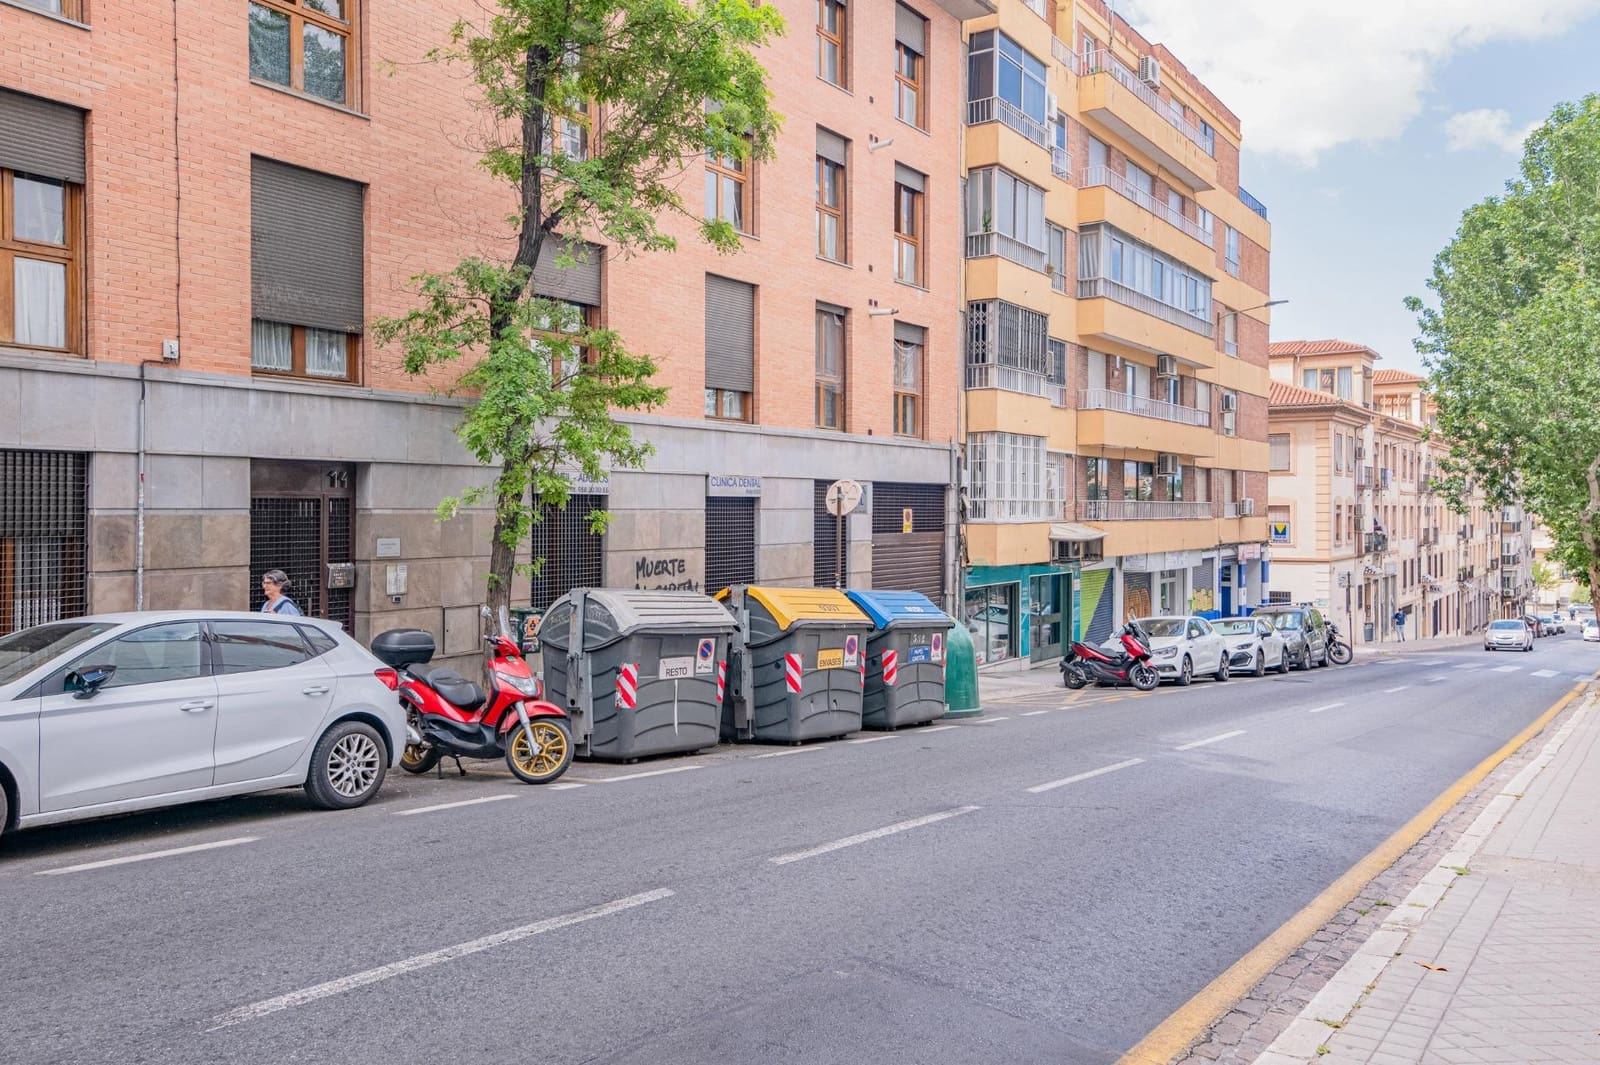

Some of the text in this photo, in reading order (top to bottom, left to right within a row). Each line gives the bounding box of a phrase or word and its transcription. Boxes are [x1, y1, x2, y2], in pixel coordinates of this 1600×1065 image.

[739, 479, 761, 488] DENTAL
[635, 556, 686, 579] MUERTE
[819, 657, 842, 667] ENVASES
[665, 667, 688, 677] RESTO
